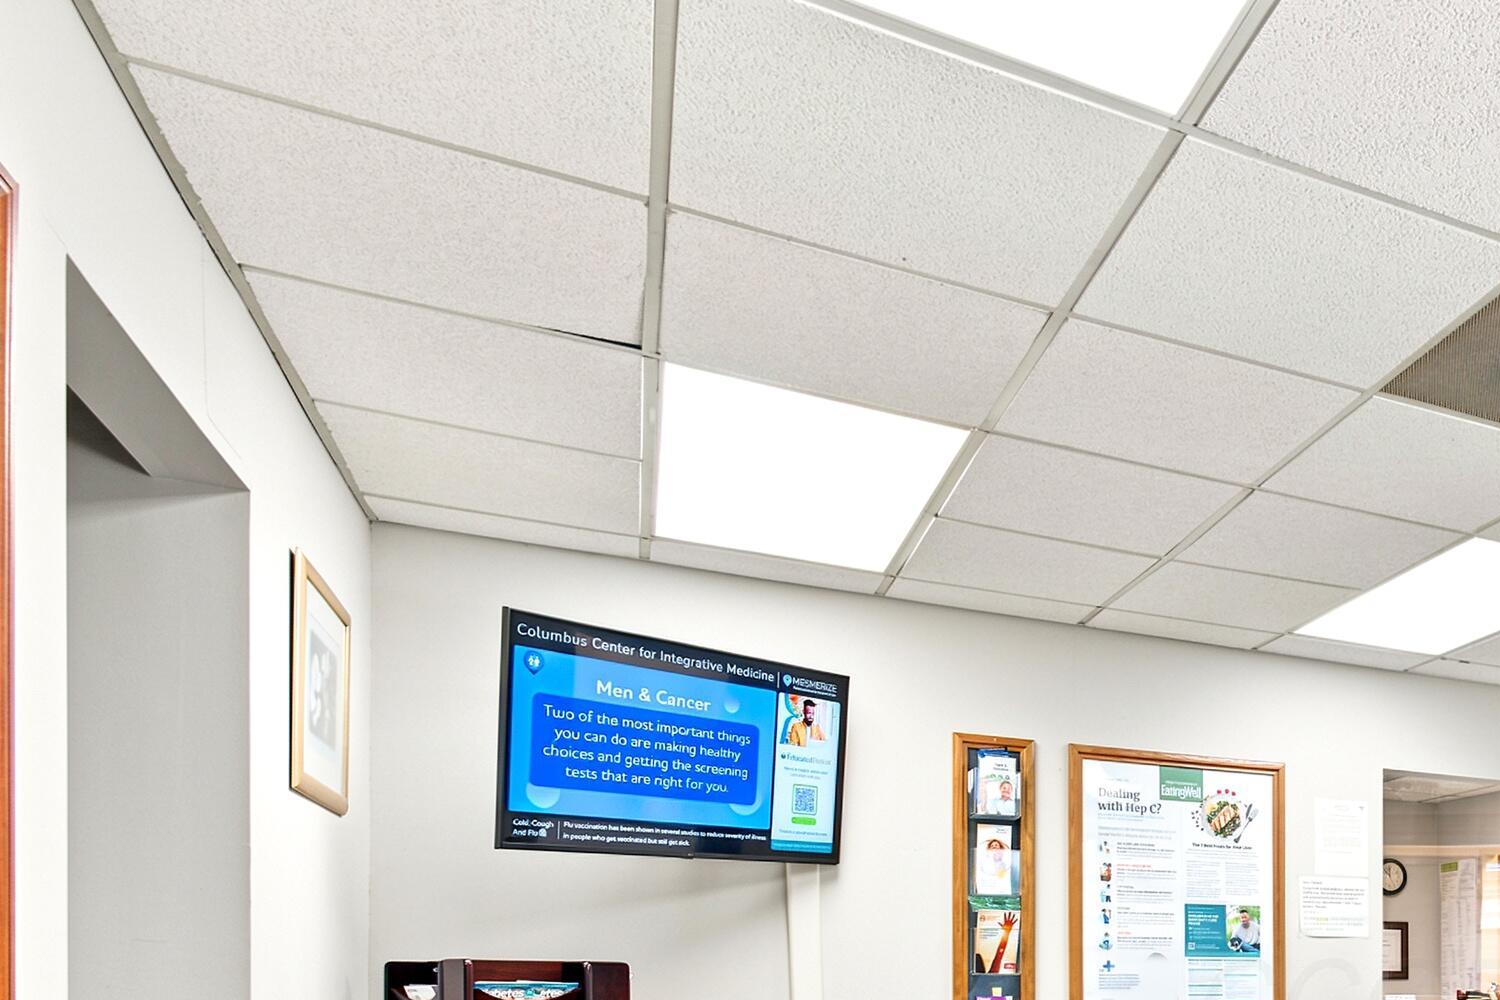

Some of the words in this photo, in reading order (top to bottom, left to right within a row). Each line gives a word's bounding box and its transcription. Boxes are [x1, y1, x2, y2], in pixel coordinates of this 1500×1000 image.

[517, 622, 588, 647] Columbus
[592, 637, 636, 656] Center
[639, 646, 657, 660] for
[660, 649, 723, 674] Integrative
[726, 662, 775, 682] Medicine
[792, 676, 838, 694] MESMERIZE
[596, 680, 633, 700] Men
[638, 687, 651, 702] &
[655, 689, 711, 712] Cancer
[543, 703, 575, 720] Two
[578, 710, 594, 723] of
[597, 713, 619, 726] the
[622, 718, 654, 732] most
[656, 719, 714, 737] important
[717, 729, 751, 747] things
[554, 728, 580, 744] you
[583, 732, 607, 743] can
[611, 733, 627, 746] do
[630, 738, 651, 749] are
[654, 740, 697, 757] making
[699, 745, 741, 762] healthy
[542, 743, 595, 761] choices
[597, 751, 621, 764] and
[624, 755, 669, 772] getting
[672, 759, 692, 771] the
[694, 763, 748, 781] screening
[564, 766, 598, 780] tests
[601, 769, 628, 783] that
[630, 774, 651, 785] are
[654, 774, 683, 790] right
[686, 778, 703, 790] for
[705, 783, 729, 794] you.
[1098, 786, 1141, 802] Dealing
[1160, 783, 1202, 800] EatingWell
[1097, 801, 1123, 813] with
[1126, 802, 1148, 816] Hep
[1149, 803, 1163, 815] C?
[512, 828, 527, 837] And
[531, 819, 555, 829] Cough
[574, 822, 608, 831] vaccination
[617, 836, 647, 844] vaccinated
